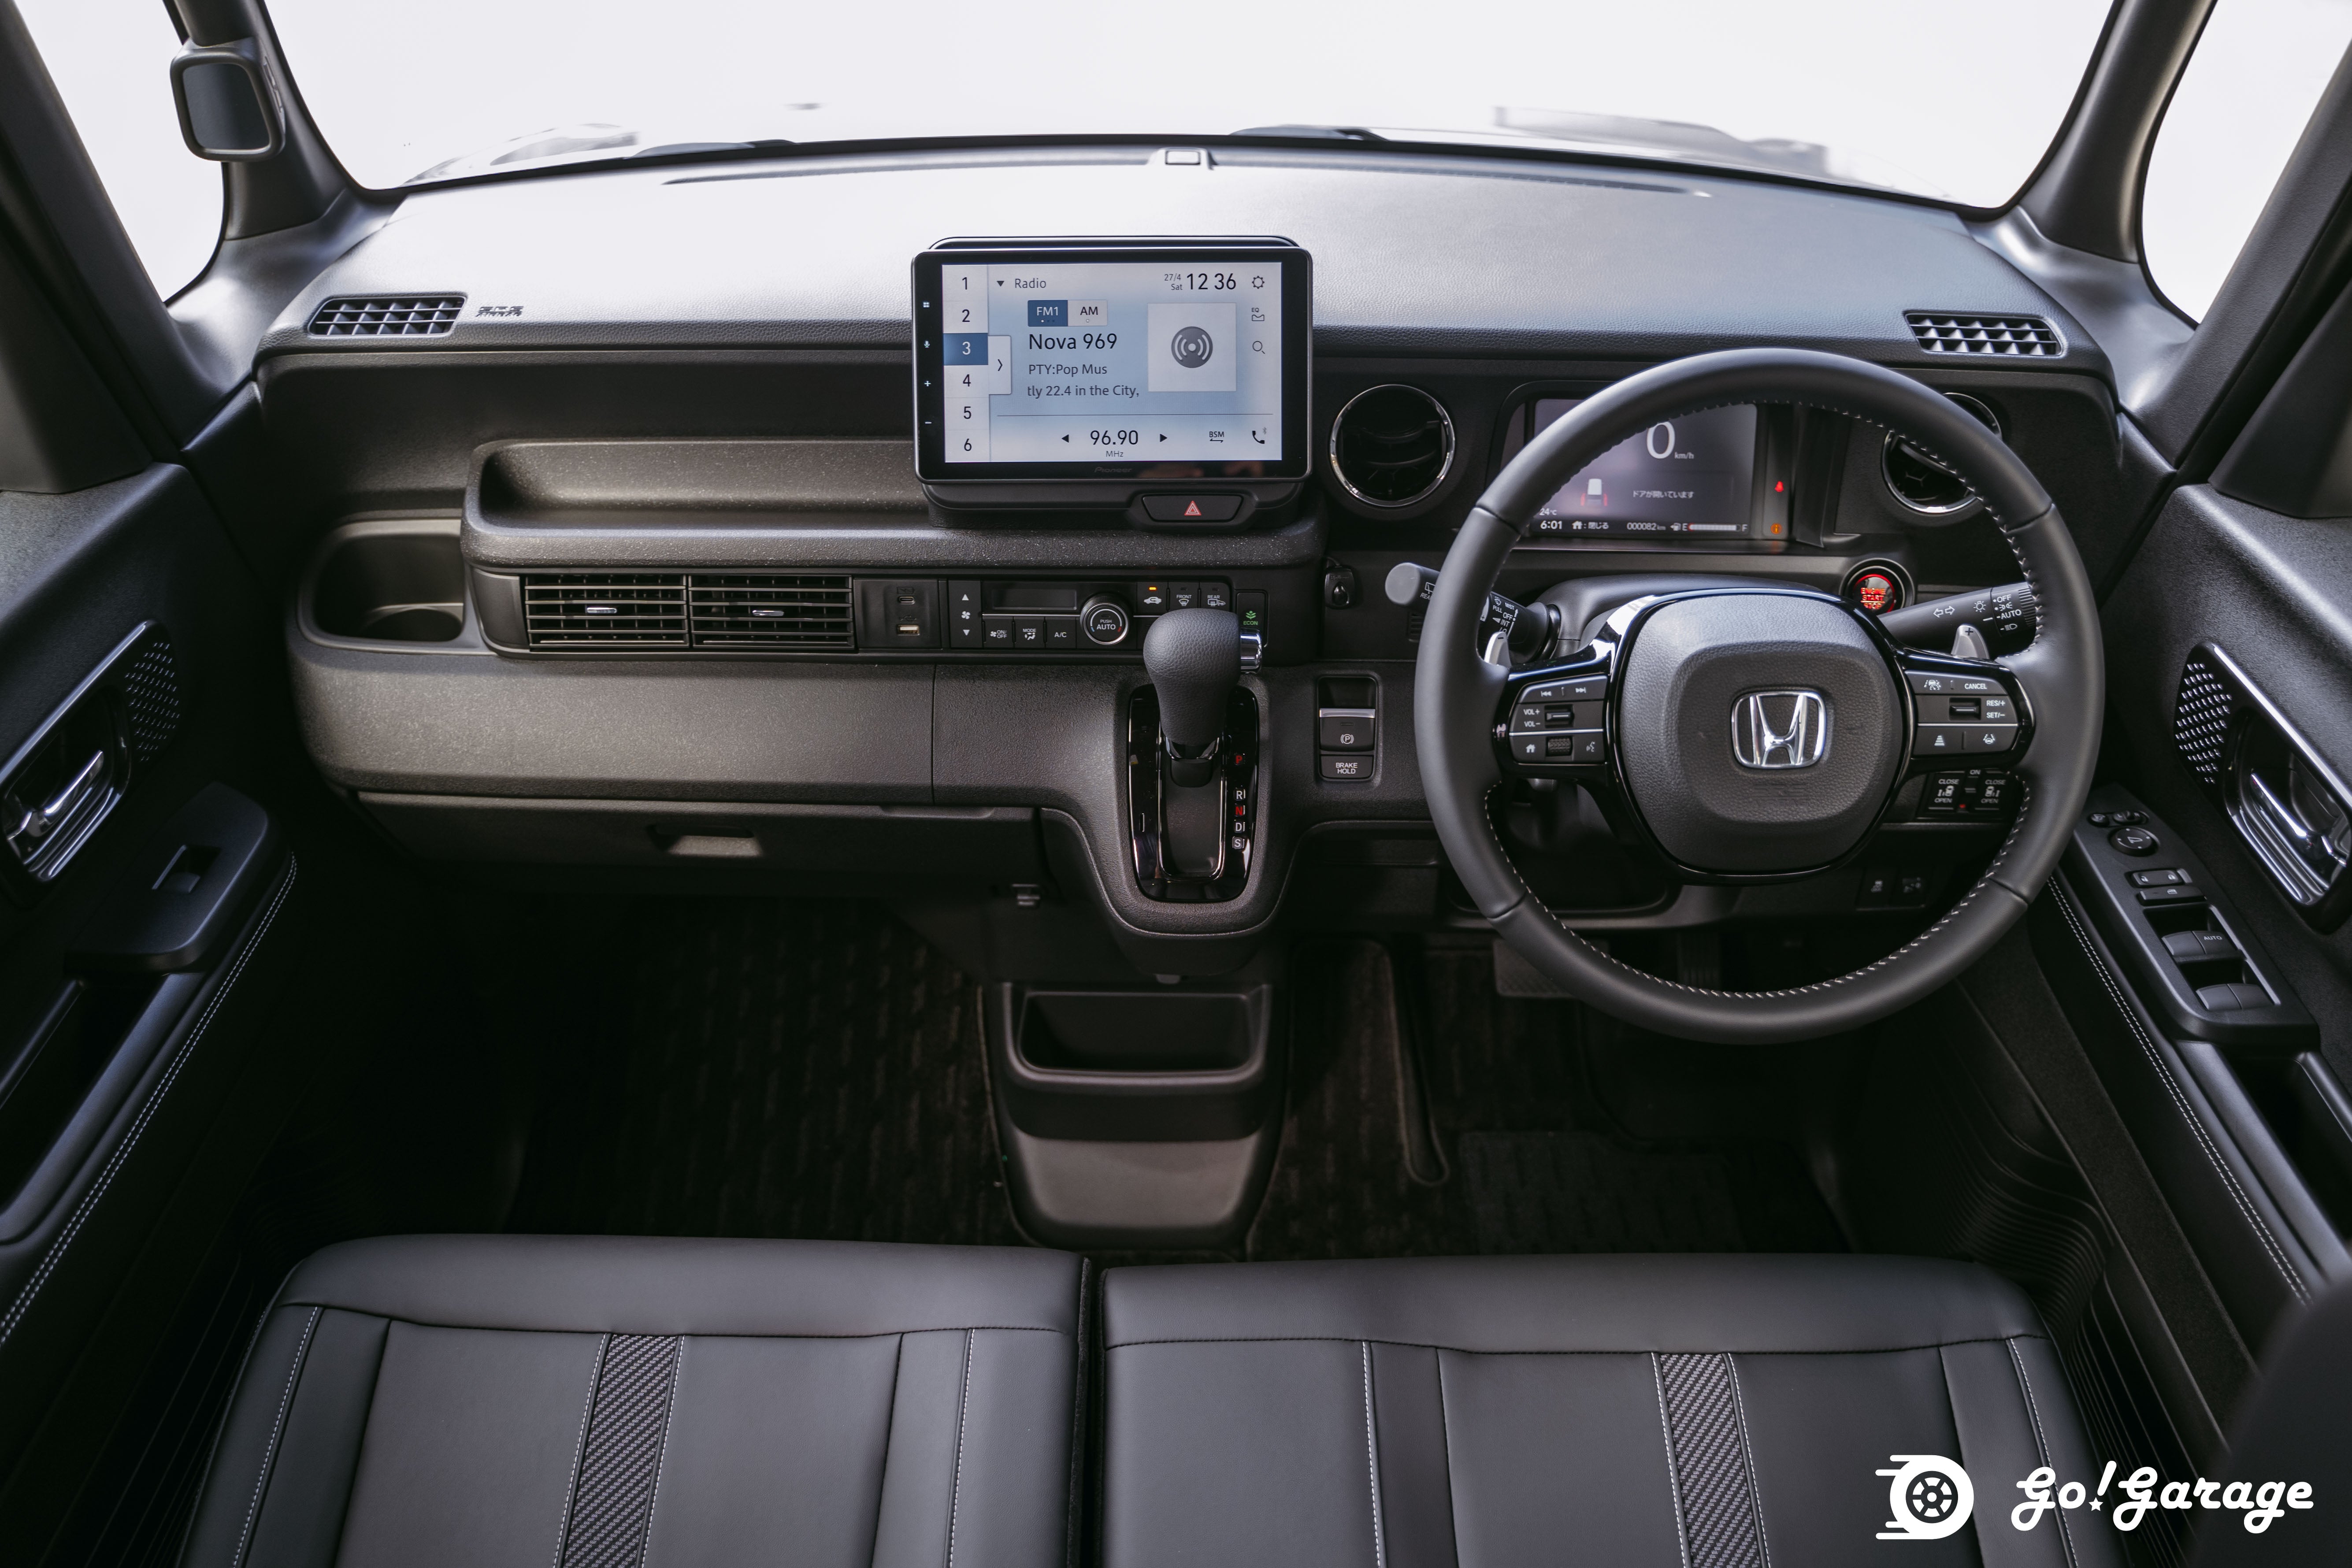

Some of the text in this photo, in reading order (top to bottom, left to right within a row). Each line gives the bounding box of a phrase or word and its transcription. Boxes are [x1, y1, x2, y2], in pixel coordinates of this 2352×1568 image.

[962, 277, 967, 289] 1
[1015, 278, 1046, 288] Radio
[962, 309, 970, 322] 2
[1037, 307, 1058, 315] FM1
[1080, 307, 1098, 315] AM
[1030, 334, 1117, 349] Nova 969
[963, 342, 970, 355] 3
[1029, 364, 1107, 377] PTY:Pop Mus
[963, 374, 971, 386] 4
[1028, 385, 1139, 399] tly 22.4 in the City,
[964, 407, 971, 419] 5
[1091, 430, 1138, 445] 96.90
[1647, 422, 1675, 459] 0
[964, 439, 972, 451] 6
[1541, 521, 1562, 529] 6:01
[1493, 605, 1502, 613] PULL
[2001, 609, 2022, 619] AUTO
[1502, 612, 1513, 620] OFF
[1237, 791, 1242, 799] R
[1236, 807, 1243, 815] N
[1236, 823, 1242, 831] D
[1235, 839, 1241, 847] S
